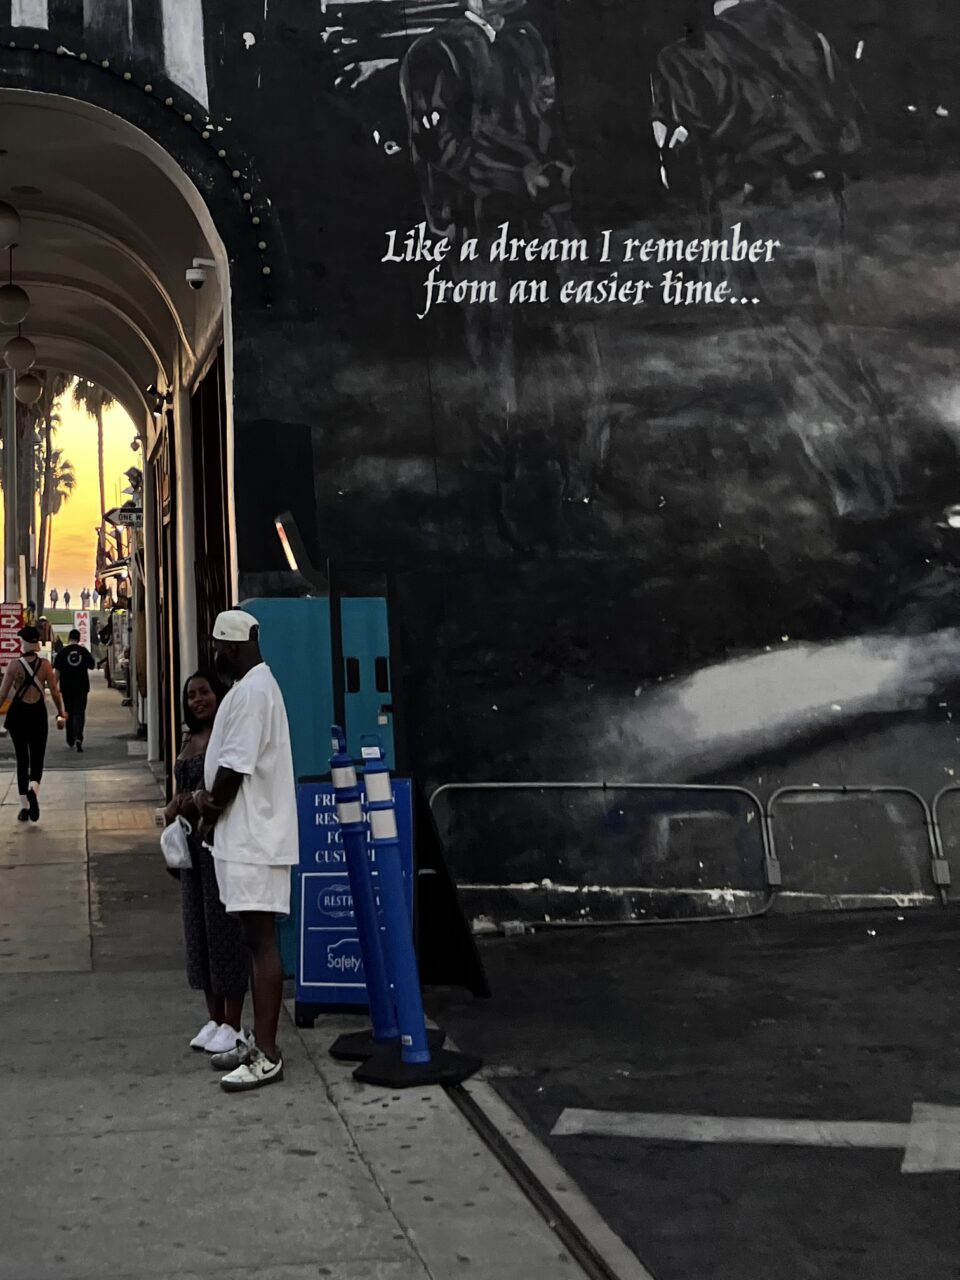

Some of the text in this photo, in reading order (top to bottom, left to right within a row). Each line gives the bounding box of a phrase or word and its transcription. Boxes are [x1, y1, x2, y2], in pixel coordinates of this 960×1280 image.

[381, 221, 782, 263] Like a dream I remember
[416, 264, 761, 320] from an easier time...
